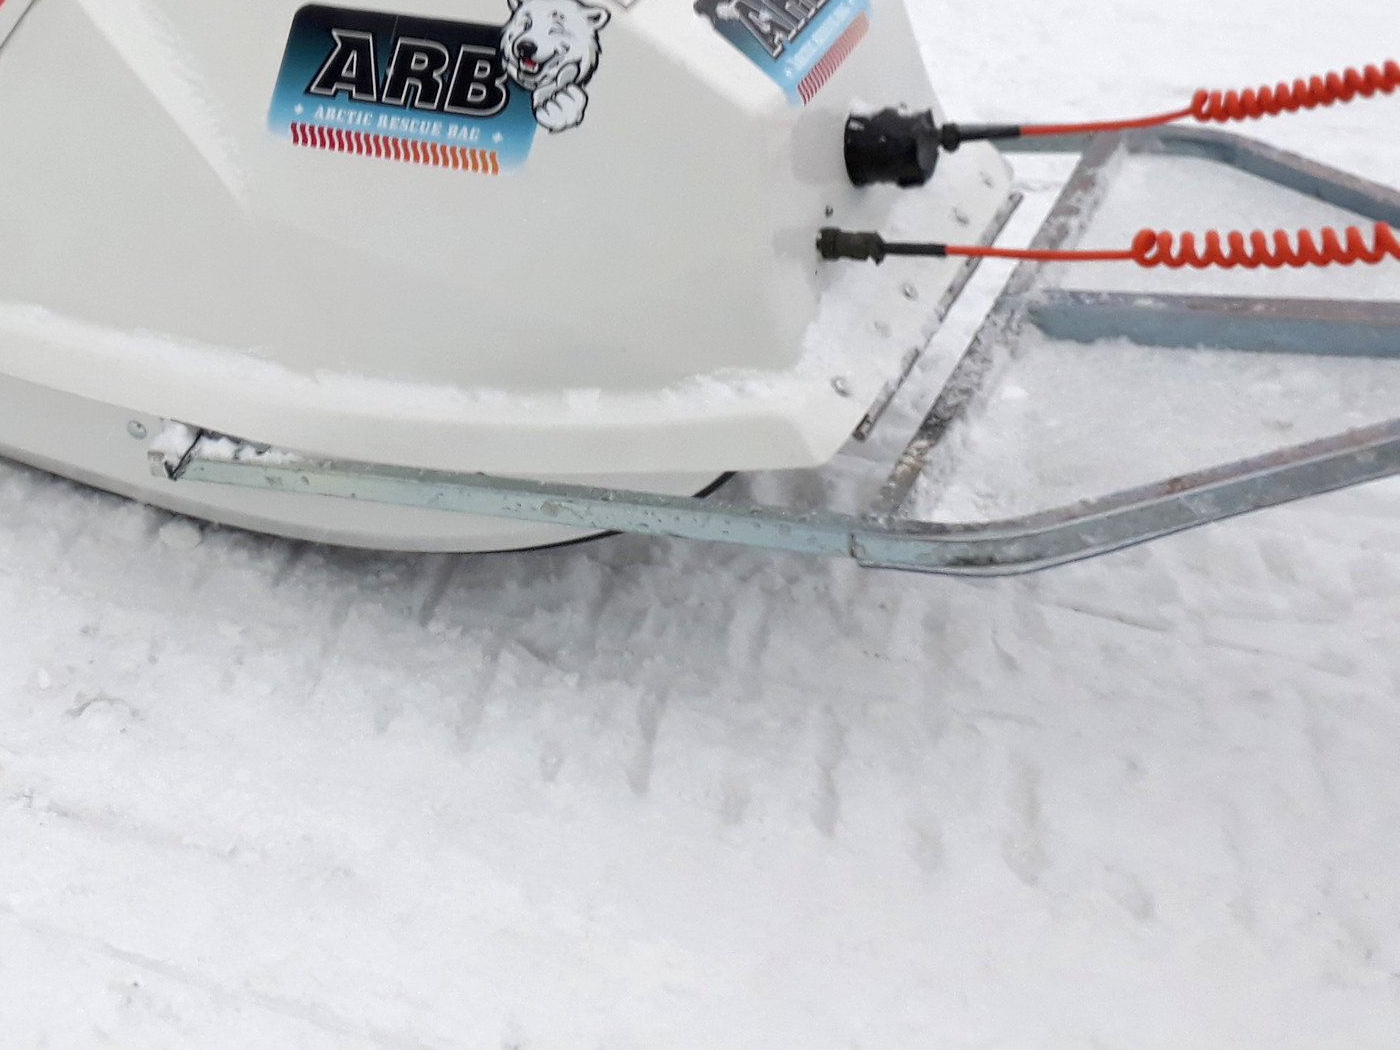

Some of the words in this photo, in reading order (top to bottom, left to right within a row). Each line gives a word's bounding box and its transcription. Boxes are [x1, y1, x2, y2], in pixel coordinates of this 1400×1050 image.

[304, 27, 511, 117] ARB
[313, 104, 373, 127] ARCTIC
[377, 113, 442, 137] RESCUE
[447, 122, 481, 142] BAG
